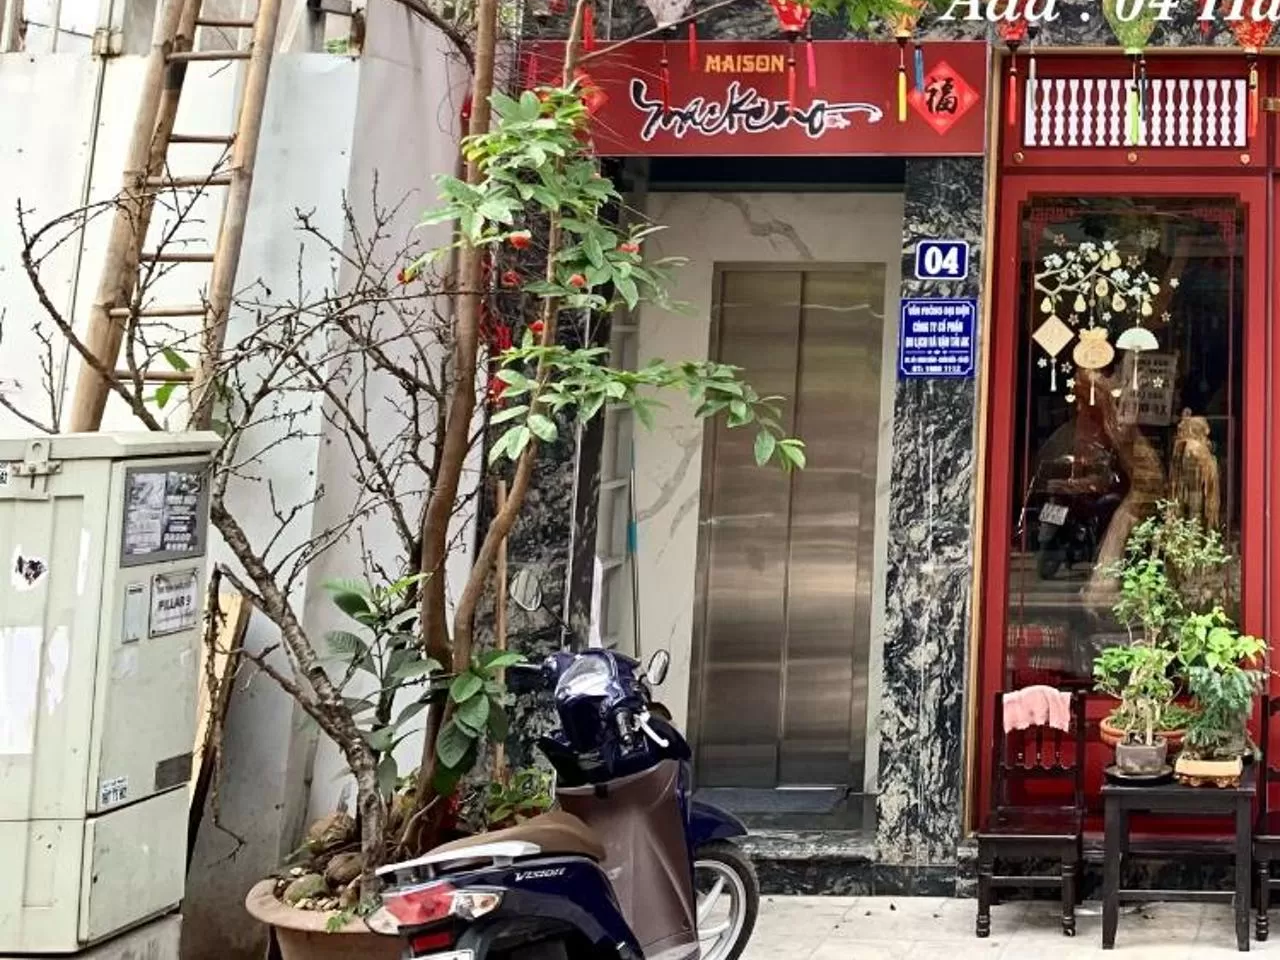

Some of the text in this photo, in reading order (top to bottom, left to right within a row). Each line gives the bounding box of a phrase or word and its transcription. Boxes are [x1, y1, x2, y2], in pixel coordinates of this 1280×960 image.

[704, 53, 785, 74] MAISON
[926, 76, 960, 116] 福
[924, 245, 959, 275] 04
[514, 867, 567, 883] VISION
